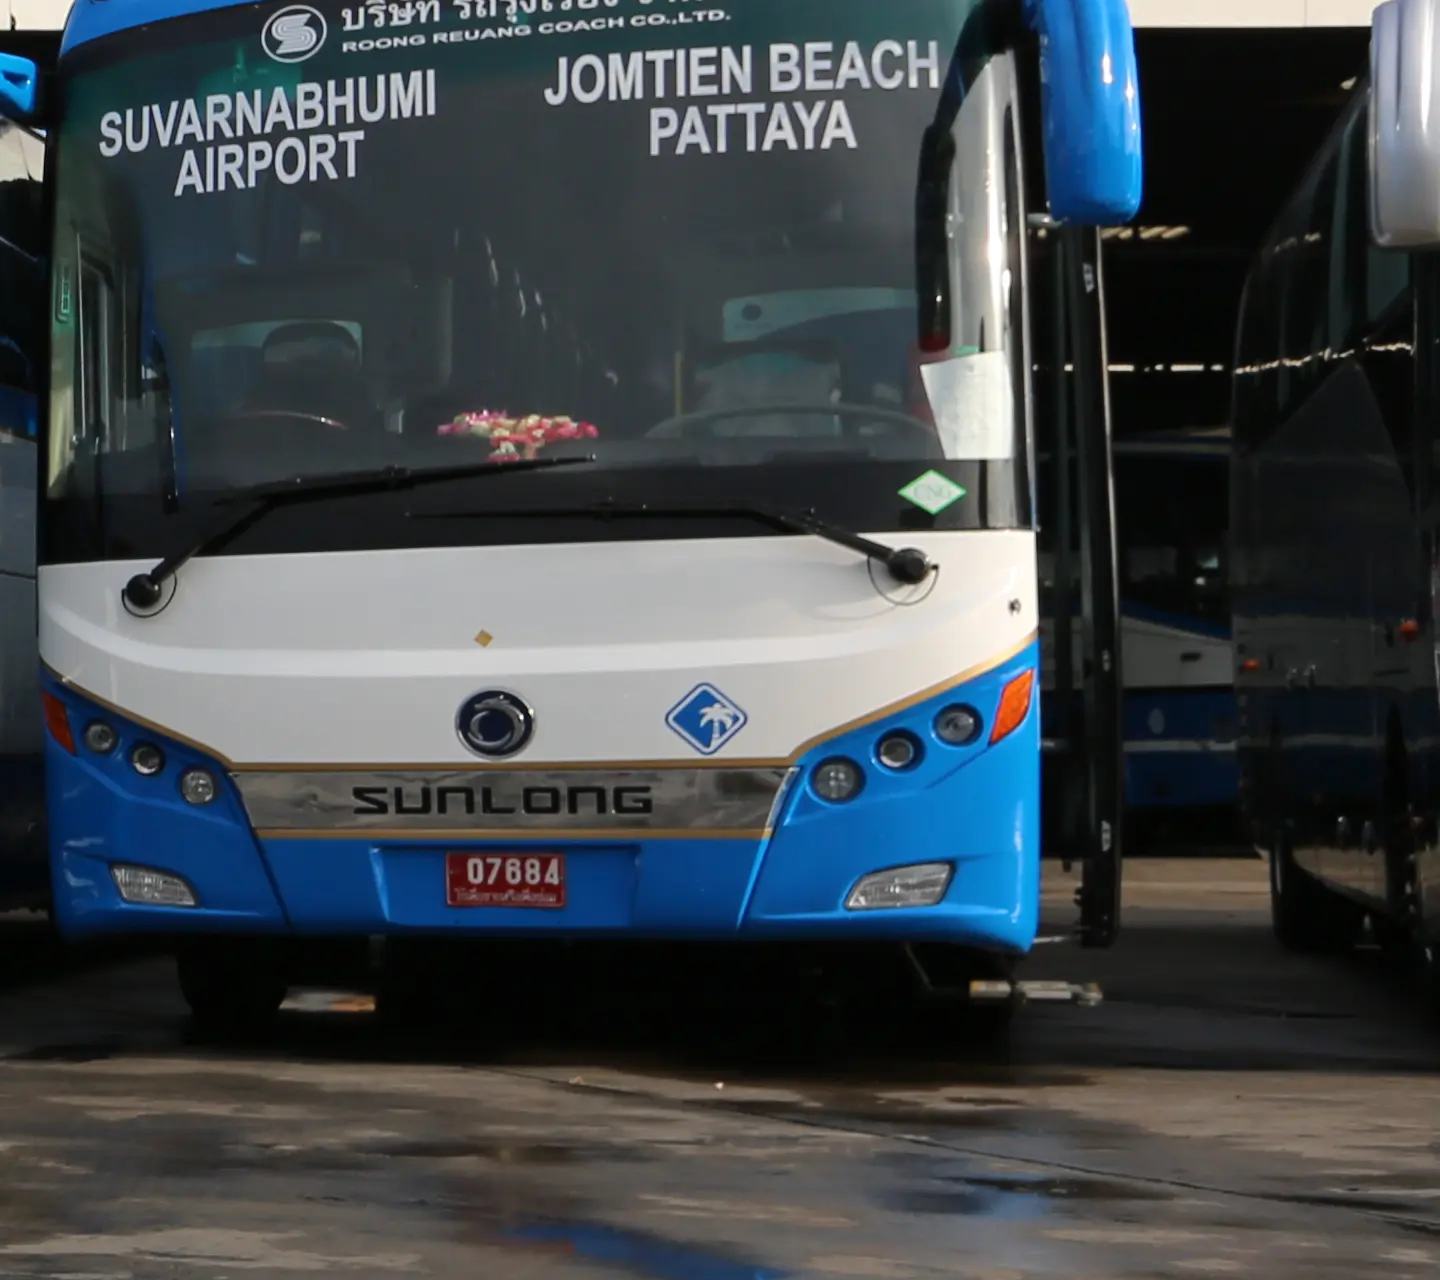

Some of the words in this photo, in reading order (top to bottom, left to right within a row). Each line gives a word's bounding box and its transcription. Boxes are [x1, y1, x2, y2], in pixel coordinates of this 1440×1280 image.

[341, 34, 426, 53] ROONG
[432, 24, 532, 44] REUANG
[538, 15, 625, 35] COACH
[630, 8, 731, 28] CO.,LTD.
[544, 44, 752, 107] JOMTIEN
[768, 39, 940, 94] BEACH
[98, 68, 437, 158] SUVARNABHUMI
[648, 99, 858, 157] PATTAYA
[174, 129, 365, 197] AIRPORT
[352, 785, 653, 816] SUNLONG
